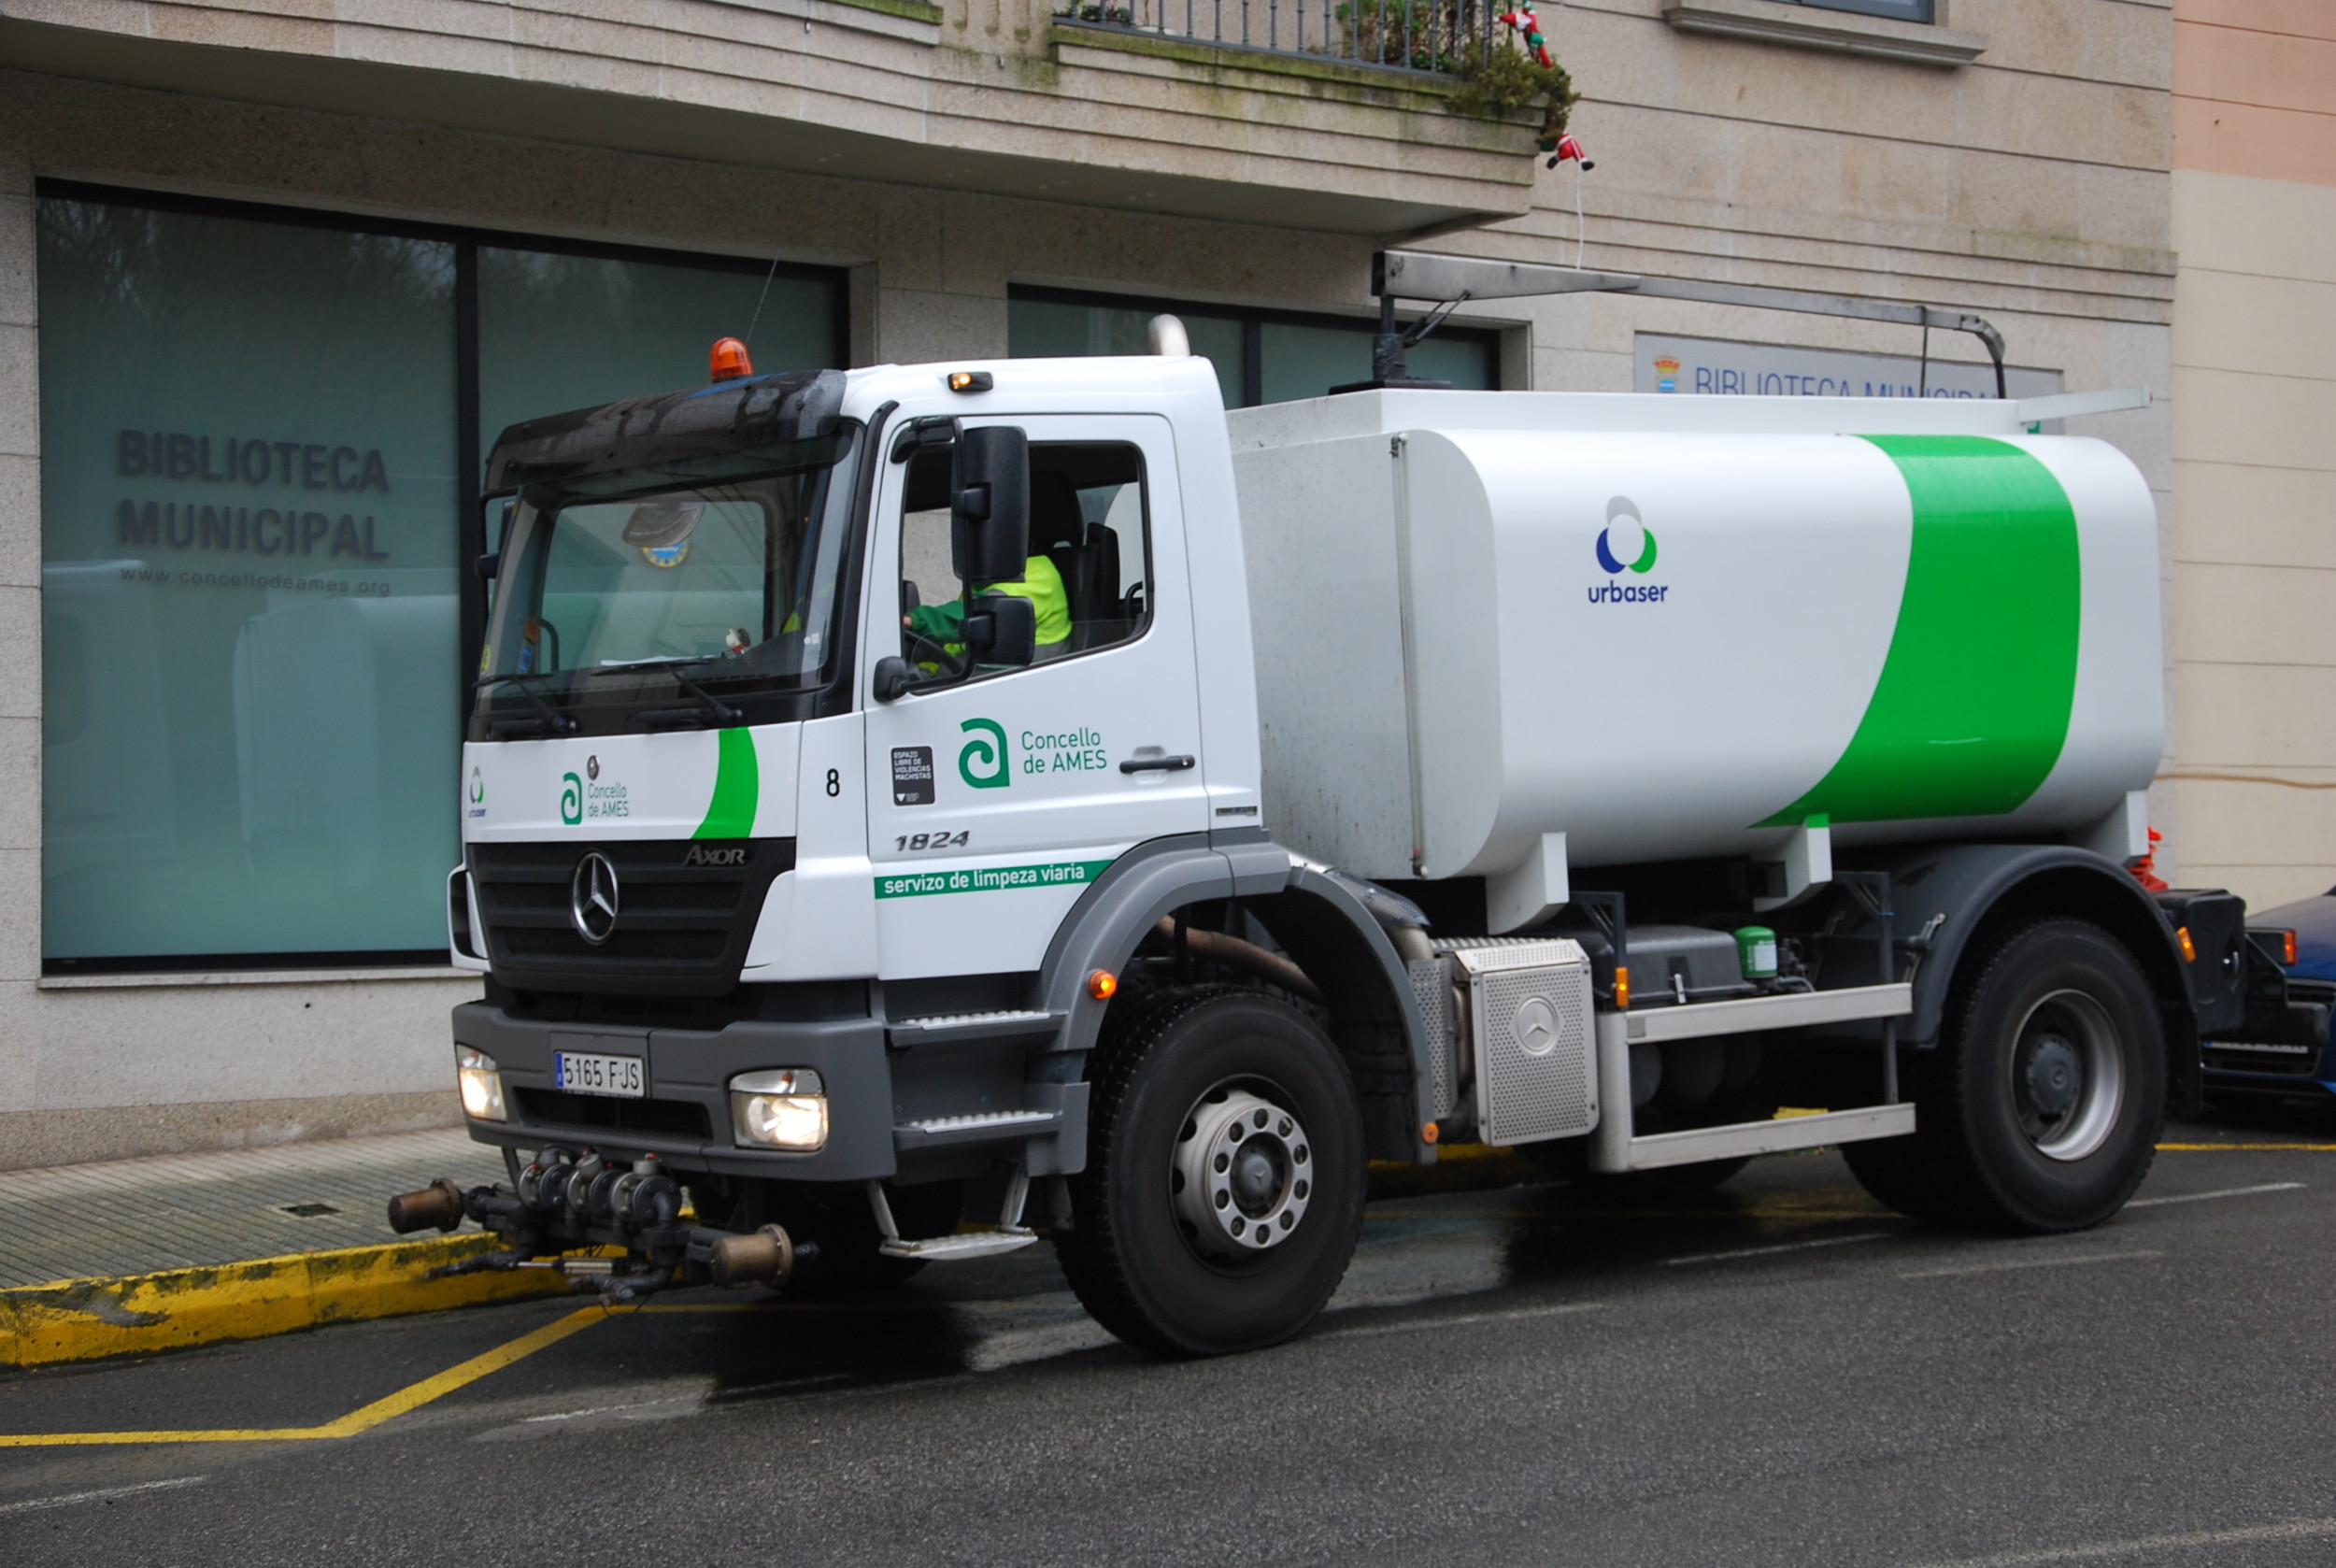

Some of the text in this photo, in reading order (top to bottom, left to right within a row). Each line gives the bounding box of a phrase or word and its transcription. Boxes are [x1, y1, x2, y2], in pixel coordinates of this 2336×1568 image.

[119, 429, 390, 492] BIBLIOTECA
[119, 499, 390, 559] MUNICIPAL
[121, 568, 391, 596] www.concellodeames.org
[1588, 578, 1669, 604] urbaser
[1021, 727, 1101, 750] Concello
[1023, 748, 1107, 774] de AMES
[588, 782, 628, 799] Concello
[826, 768, 840, 797] 8
[588, 801, 630, 818] de AMES
[895, 830, 971, 851] 1824
[884, 862, 1086, 894] servizo de limpeza viaria
[564, 1057, 640, 1090] 5165 FJS
